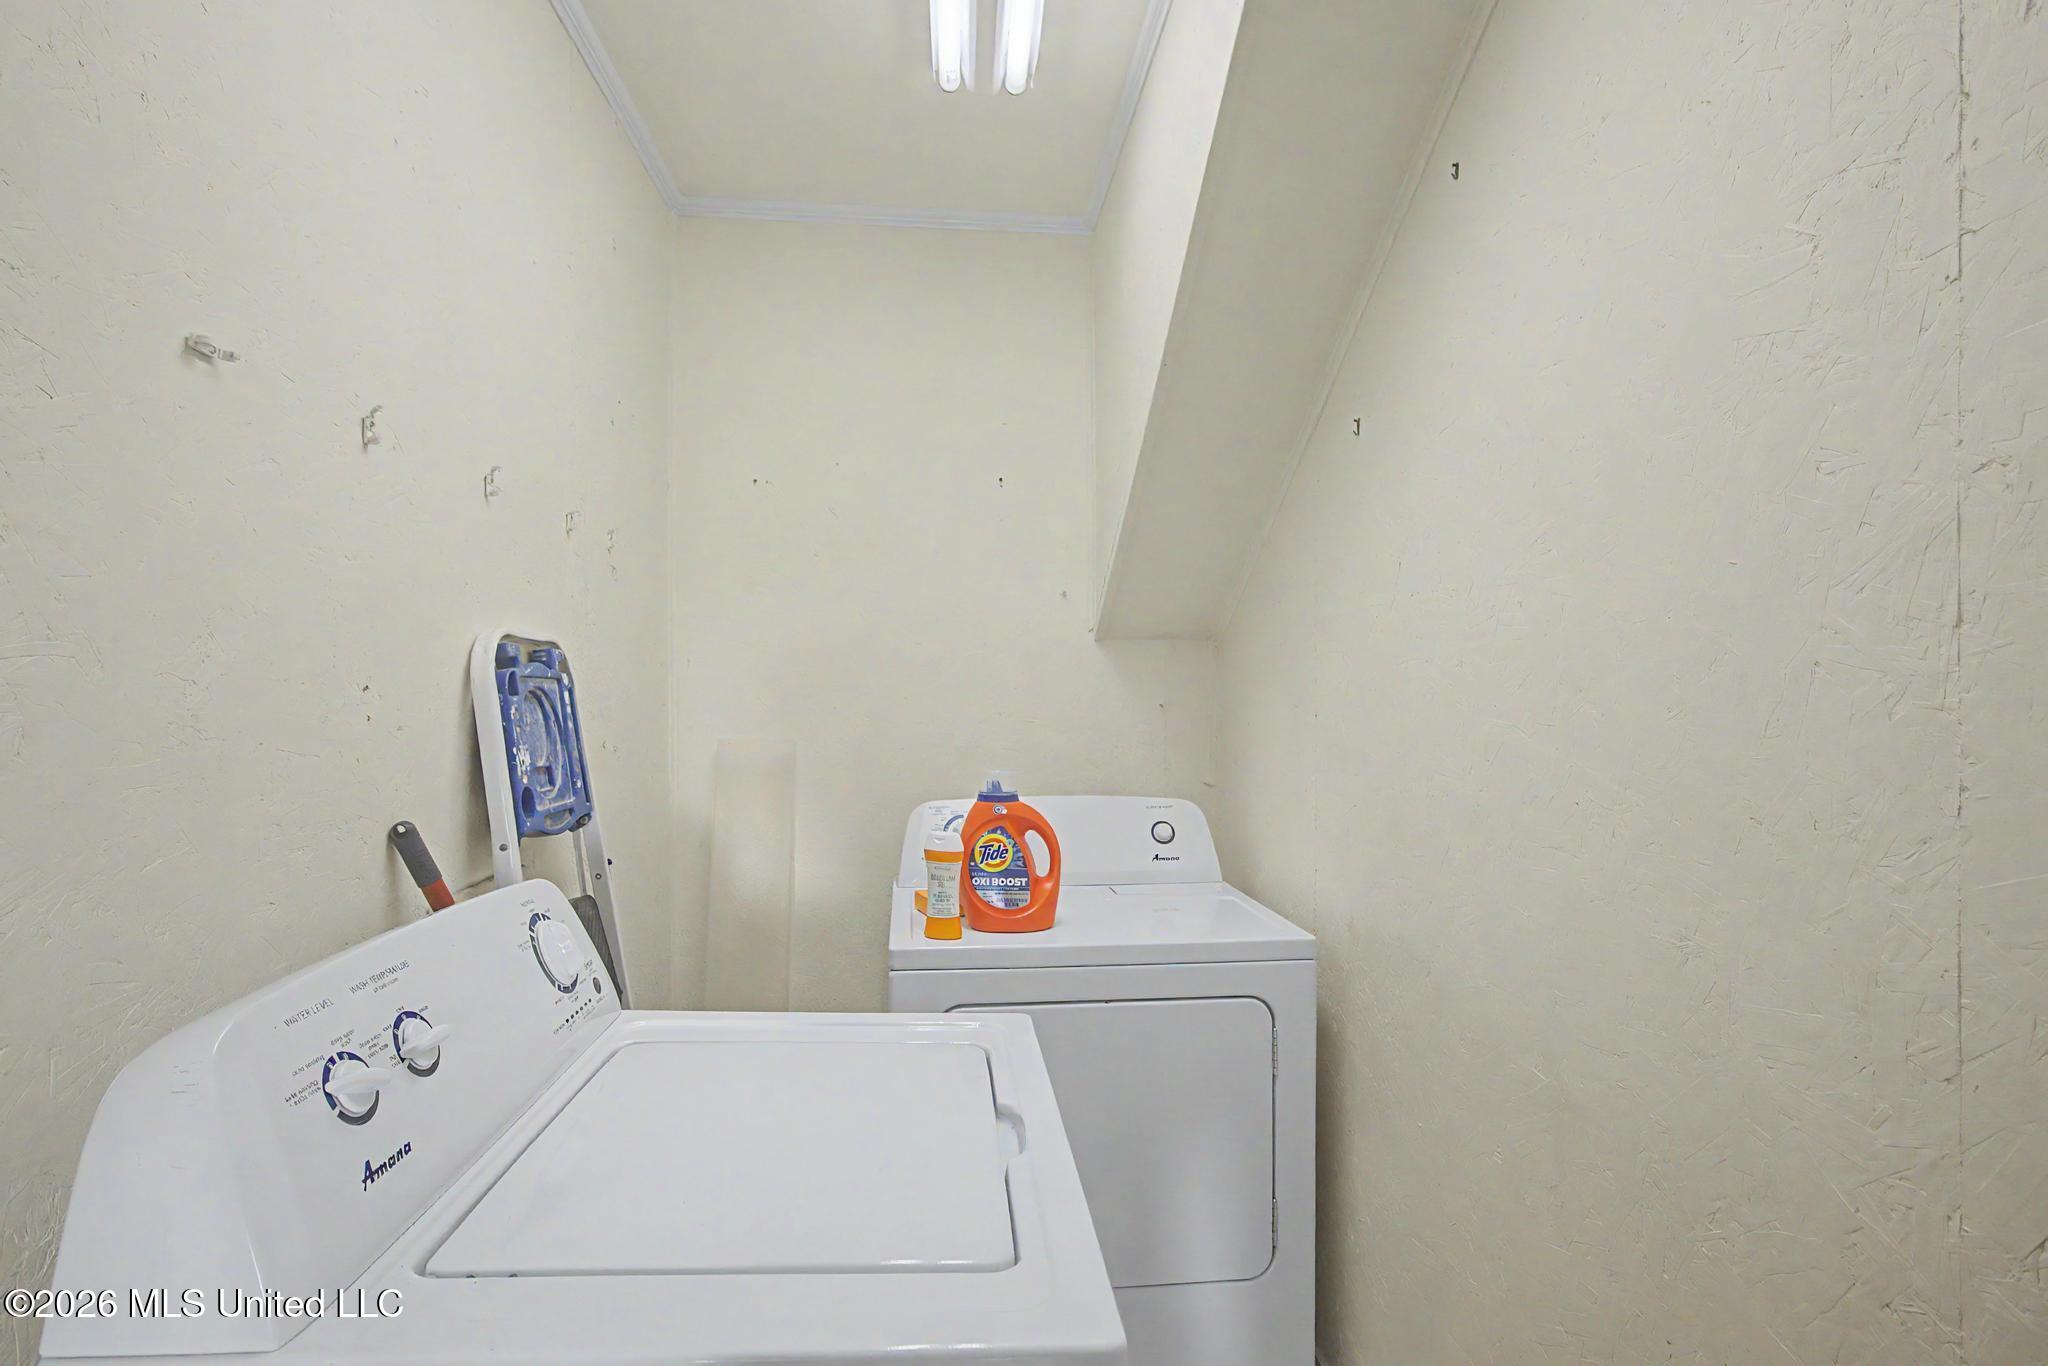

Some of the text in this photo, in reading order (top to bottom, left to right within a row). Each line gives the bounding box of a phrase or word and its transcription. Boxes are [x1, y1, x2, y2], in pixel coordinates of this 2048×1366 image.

[978, 843, 1009, 865] Tide
[1151, 853, 1180, 862] Amana
[972, 877, 1028, 886] OXI BOOST
[283, 998, 334, 1028] WATER LEVEL
[361, 1141, 412, 1192] Amana
